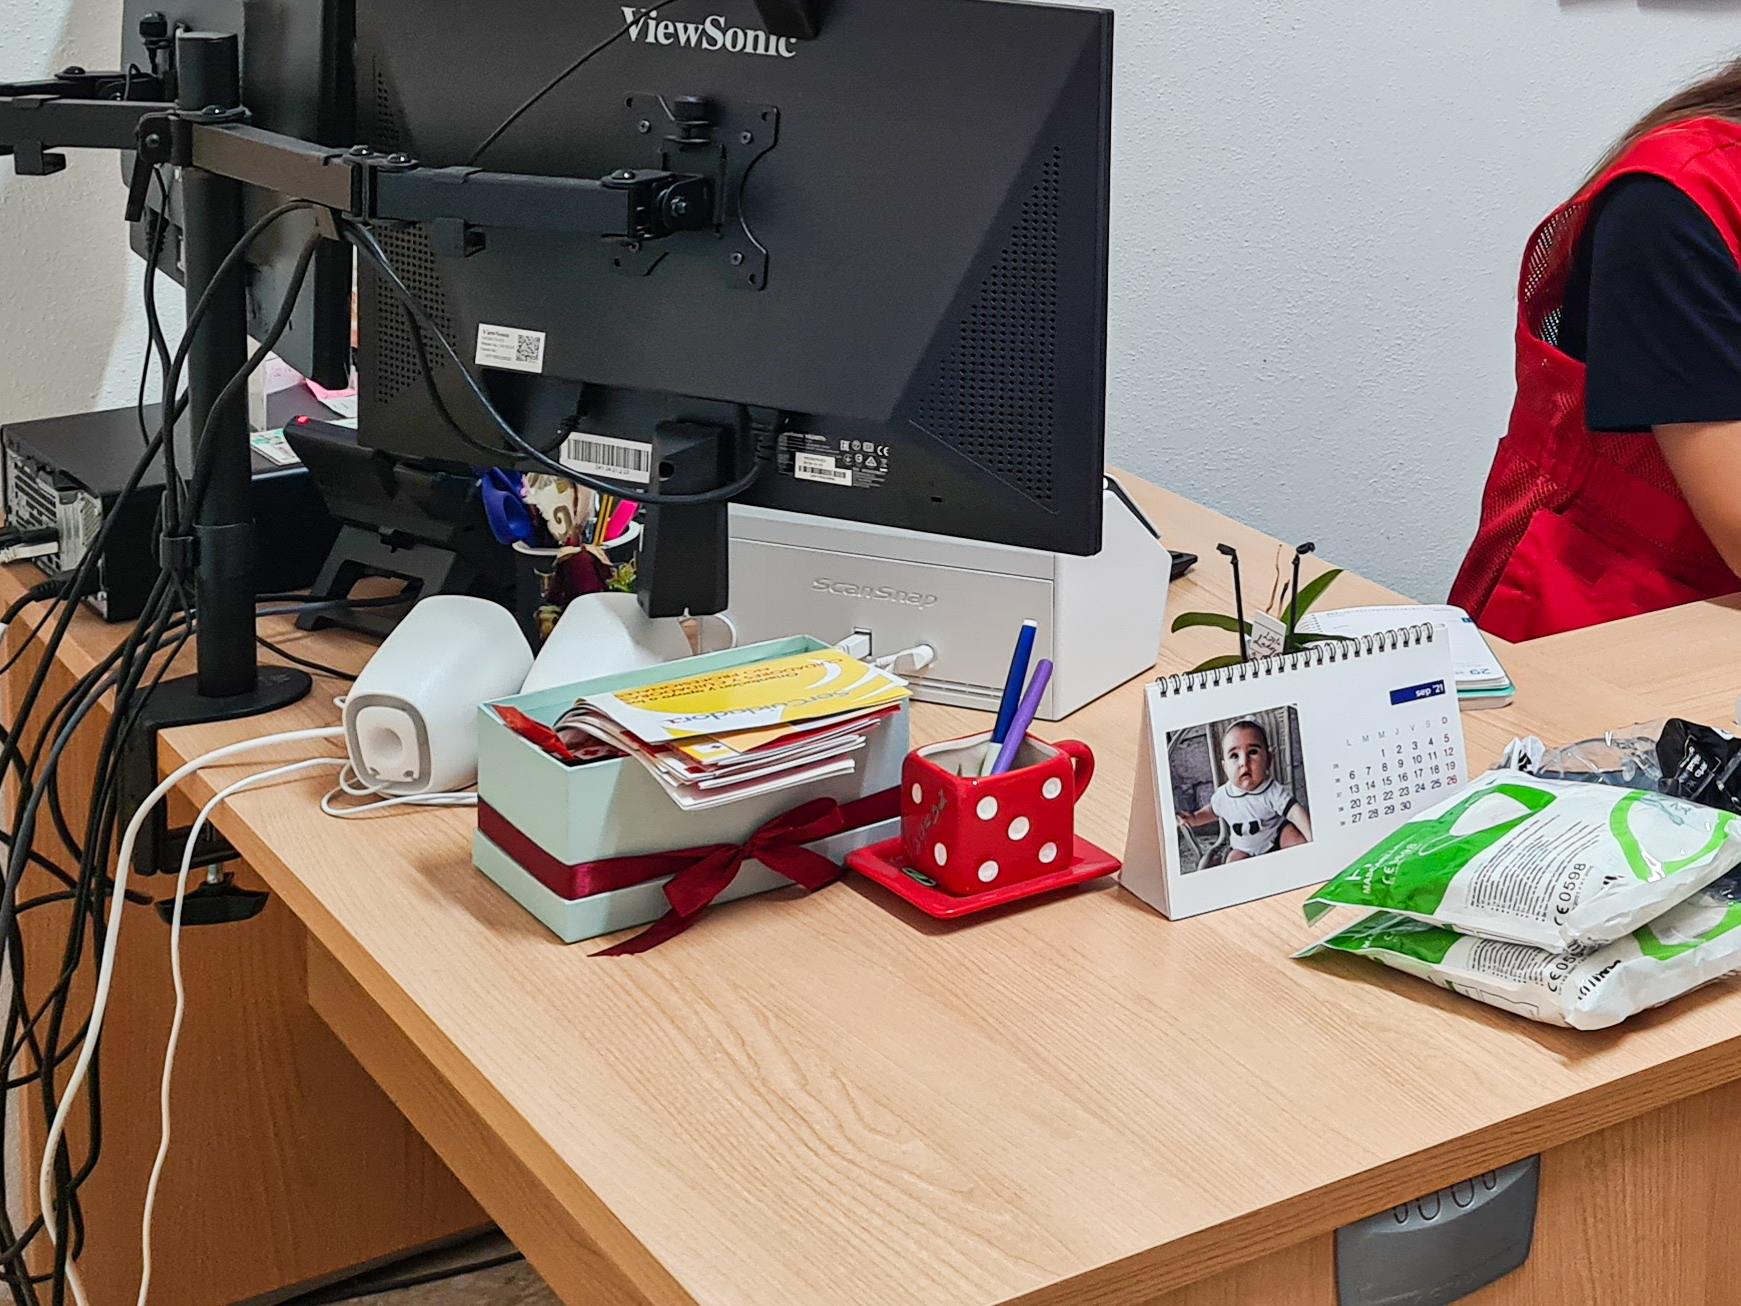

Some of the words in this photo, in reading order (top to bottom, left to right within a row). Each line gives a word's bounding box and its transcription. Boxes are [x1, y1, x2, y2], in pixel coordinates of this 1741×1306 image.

[621, 6, 798, 58] ViewSonic
[811, 576, 938, 610] ScanSnap
[1415, 688, 1432, 698] sep
[1442, 716, 1448, 725] D
[1381, 749, 1386, 758] 1
[1396, 745, 1403, 754] 2
[1412, 741, 1418, 750] 3
[1428, 737, 1434, 746] 4
[1443, 733, 1450, 743] 5
[1349, 770, 1356, 780] 6
[1365, 766, 1372, 775] 7
[1381, 762, 1388, 772] 8
[1397, 759, 1404, 768] 9
[1412, 754, 1422, 764] 10
[1428, 751, 1438, 761] 11
[1444, 747, 1454, 757] 12
[1349, 784, 1360, 794] 13
[1365, 780, 1376, 790] 14
[1382, 776, 1392, 787] 15
[1398, 773, 1409, 783] 16
[1414, 768, 1424, 779] 17
[1430, 765, 1440, 775] 18
[1446, 761, 1456, 771] 19
[1350, 798, 1362, 808] 20
[1366, 795, 1377, 805] 21
[1382, 790, 1394, 801] 22
[1398, 786, 1410, 797] 23
[1414, 782, 1426, 793] 24
[1430, 779, 1442, 789] 25
[1446, 775, 1458, 785] 26
[1351, 812, 1363, 824] 27
[1368, 808, 1379, 820] 28
[1384, 804, 1395, 816] 29
[1400, 800, 1412, 811] 30
